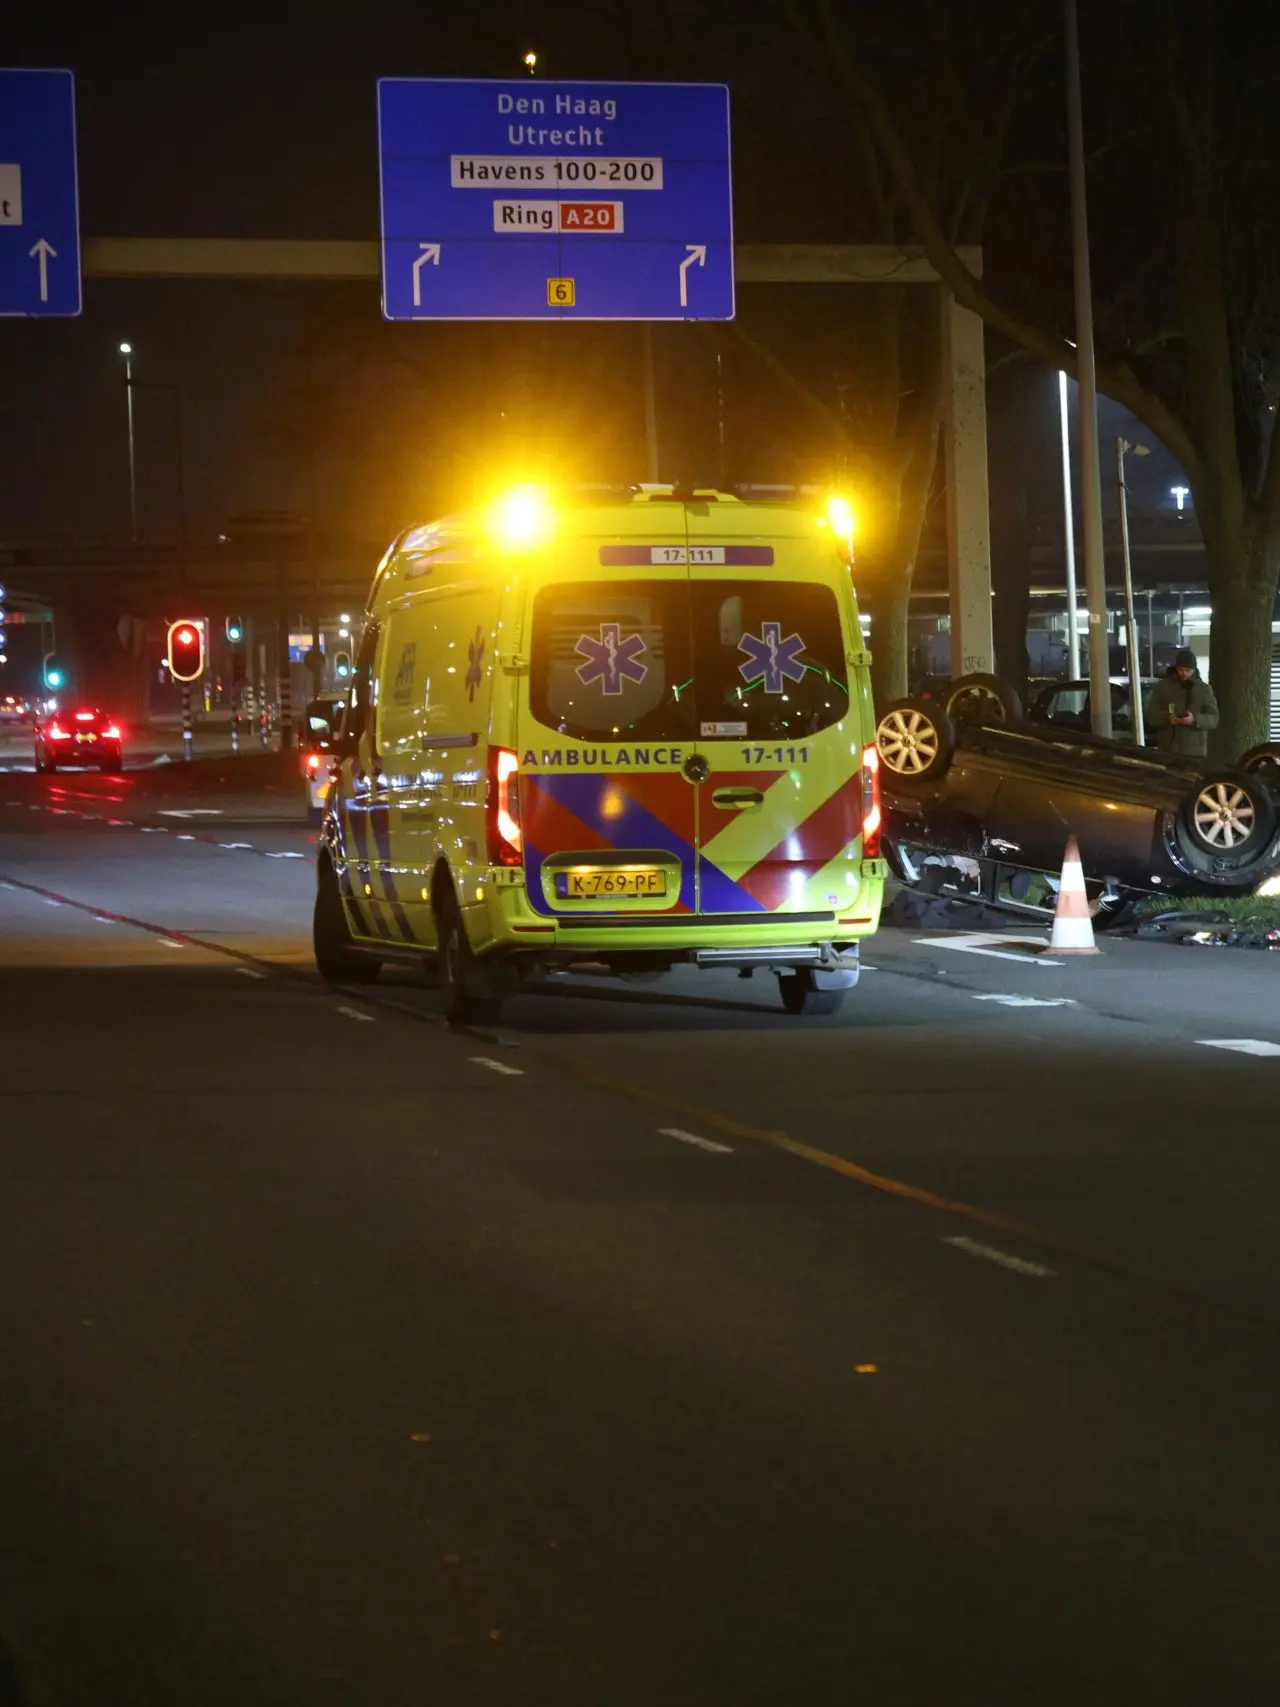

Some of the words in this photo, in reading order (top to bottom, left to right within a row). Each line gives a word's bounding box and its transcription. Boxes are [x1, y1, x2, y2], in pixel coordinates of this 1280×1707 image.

[497, 93, 545, 115] Den
[555, 95, 617, 120] Haag
[508, 125, 605, 146] Utrecht
[459, 161, 545, 180] Havens
[554, 162, 655, 181] 100-200
[502, 205, 553, 229] Ring
[566, 208, 610, 225] A20
[555, 284, 567, 300] 6
[663, 550, 714, 562] 17-111
[522, 748, 682, 766] AMBULANCE
[741, 748, 809, 764] 17-111
[573, 874, 657, 892] K-769-PF
